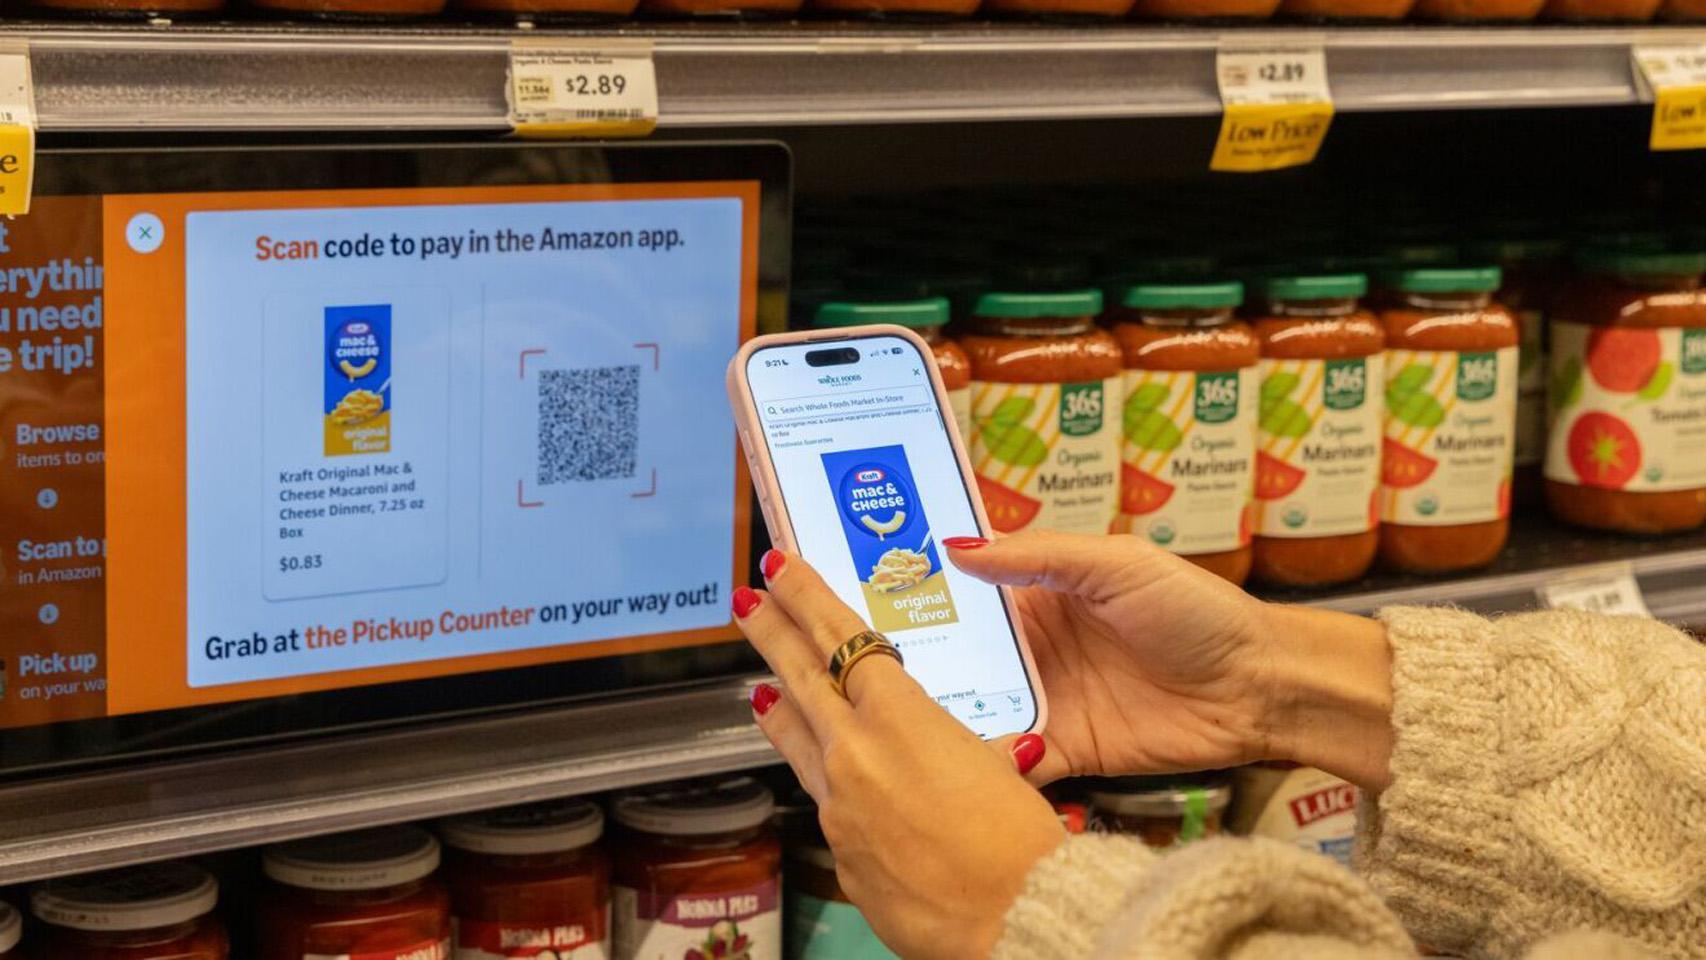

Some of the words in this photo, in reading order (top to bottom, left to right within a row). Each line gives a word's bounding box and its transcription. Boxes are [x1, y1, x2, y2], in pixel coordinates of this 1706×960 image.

[566, 75, 626, 95] $2.89
[255, 235, 319, 260] Scan
[324, 233, 385, 258] code
[389, 233, 416, 256] to
[420, 234, 464, 260] pay
[469, 229, 490, 253] in
[495, 229, 535, 252] the
[539, 228, 633, 251] Amazon
[637, 229, 685, 251] app.
[17, 297, 102, 332] need
[339, 336, 366, 348] mac
[366, 334, 378, 347] &
[19, 336, 94, 374] trip!
[765, 359, 781, 368] 9:21
[1327, 365, 1364, 394] 365
[1462, 360, 1496, 386] 365
[1198, 378, 1237, 407] 365
[780, 405, 804, 415] Search
[805, 402, 828, 412] Whole
[829, 400, 850, 410] Foods
[850, 398, 875, 408] Market
[876, 395, 904, 403] In-Store
[1063, 388, 1101, 420] 365
[17, 423, 100, 446] Browse
[1191, 436, 1235, 453] Organic
[18, 453, 61, 468] items
[65, 451, 82, 465] to
[1057, 448, 1102, 467] Organic
[280, 469, 314, 484] Kraft
[317, 465, 370, 481] Original
[374, 464, 400, 477] Mac
[403, 462, 413, 475] &
[861, 472, 879, 481] Kraft
[280, 489, 326, 502] Cheese
[329, 483, 388, 498] Macaroni
[391, 480, 416, 493] and
[852, 485, 885, 499] mac
[885, 482, 898, 496] &
[280, 507, 326, 521] Cheese
[329, 503, 376, 516] Dinner,
[379, 500, 407, 513] 7.25
[410, 500, 424, 510] oz
[280, 527, 303, 540] Box
[18, 538, 73, 562] Scan
[76, 536, 99, 557] to
[280, 555, 323, 573] $0.83
[19, 570, 34, 585] in
[37, 565, 102, 584] Amazon
[893, 590, 949, 611] original
[205, 632, 267, 660] Grab
[273, 629, 299, 653] at
[305, 625, 347, 649] the
[353, 617, 434, 643] Pickup
[440, 606, 534, 635] Counter
[540, 603, 566, 623] on
[572, 598, 622, 624] your
[628, 592, 670, 614] way
[676, 582, 718, 607] out!
[908, 608, 951, 624] flavor
[19, 652, 67, 677] Pick
[69, 652, 97, 674] up
[20, 685, 40, 699] on
[44, 681, 80, 700] your
